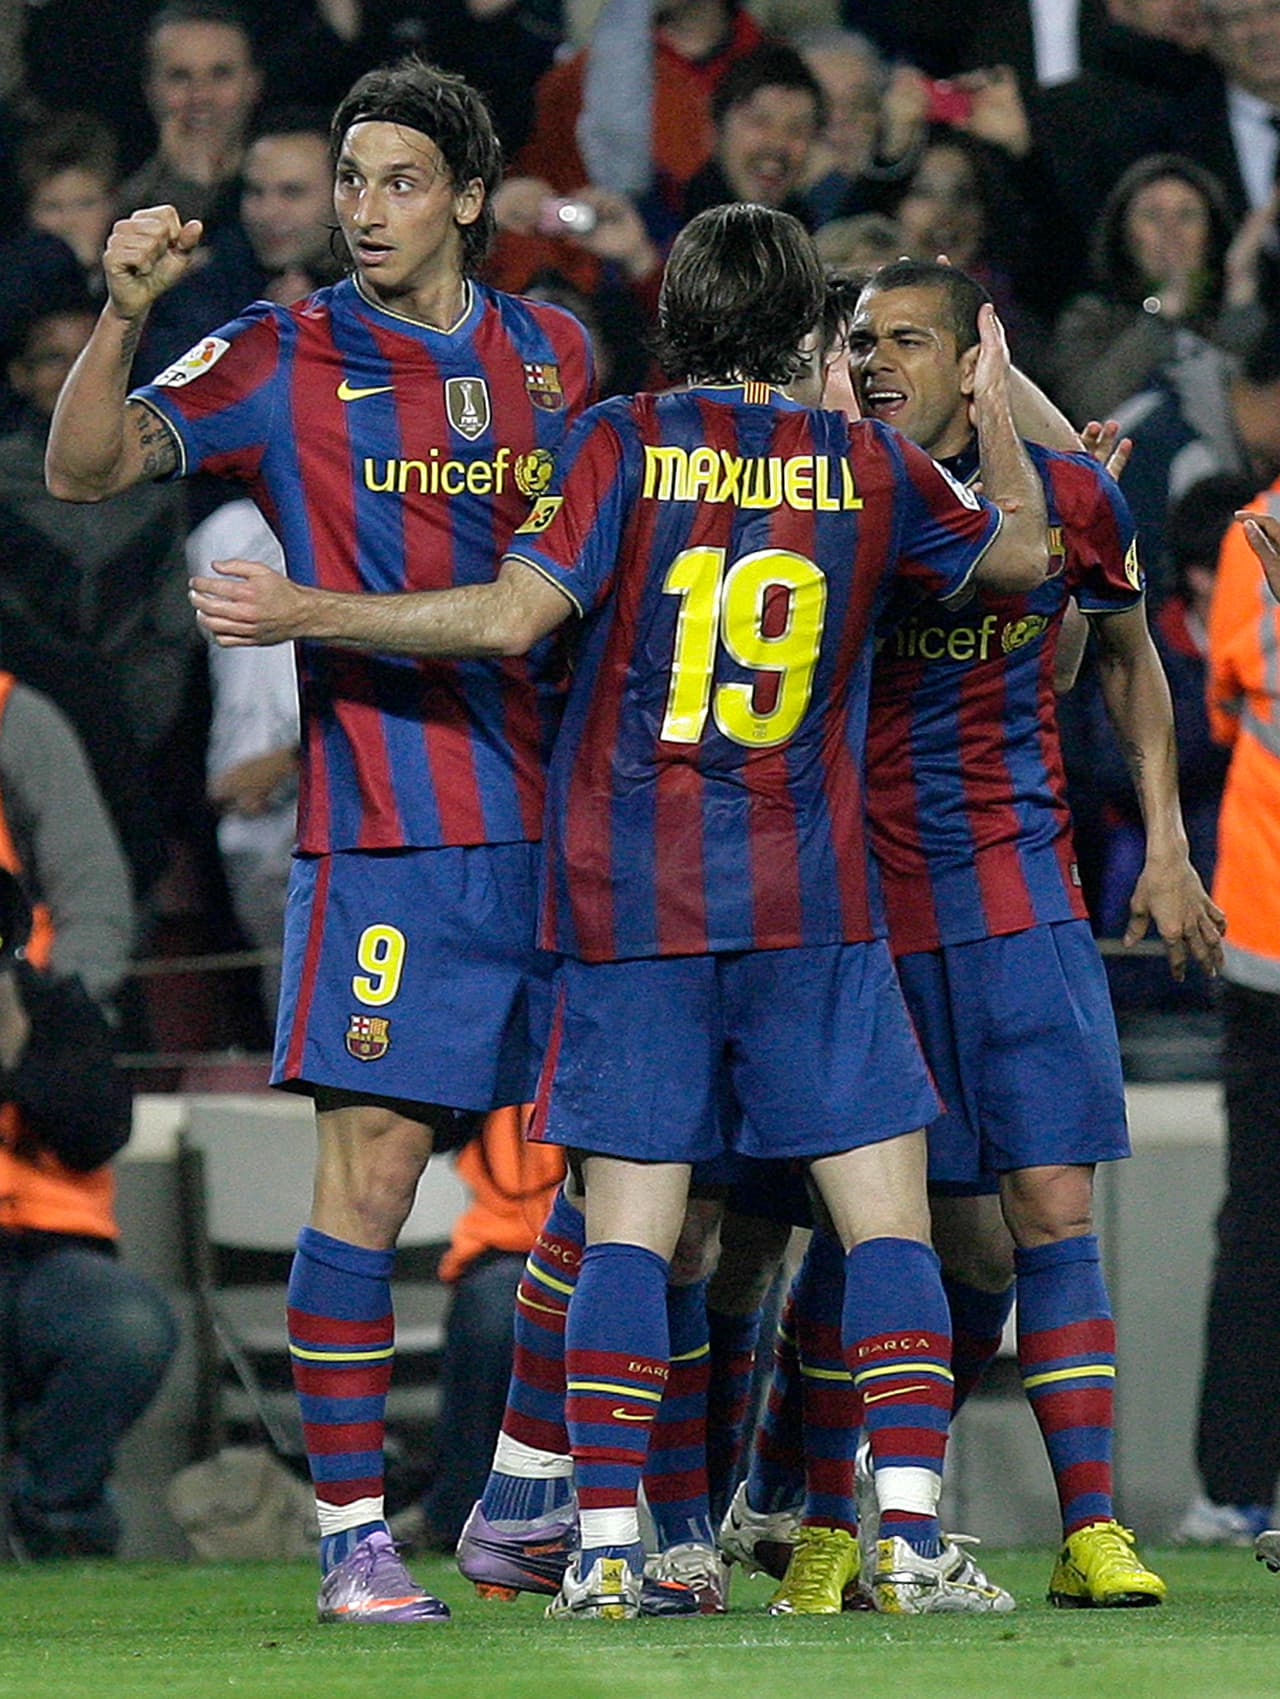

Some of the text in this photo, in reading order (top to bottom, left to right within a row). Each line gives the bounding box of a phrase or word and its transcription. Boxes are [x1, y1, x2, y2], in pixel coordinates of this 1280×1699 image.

[364, 448, 510, 495] unicef
[643, 445, 864, 511] MAXWELL
[661, 546, 826, 748] 19
[875, 615, 998, 660] icef
[352, 924, 406, 1006] 9
